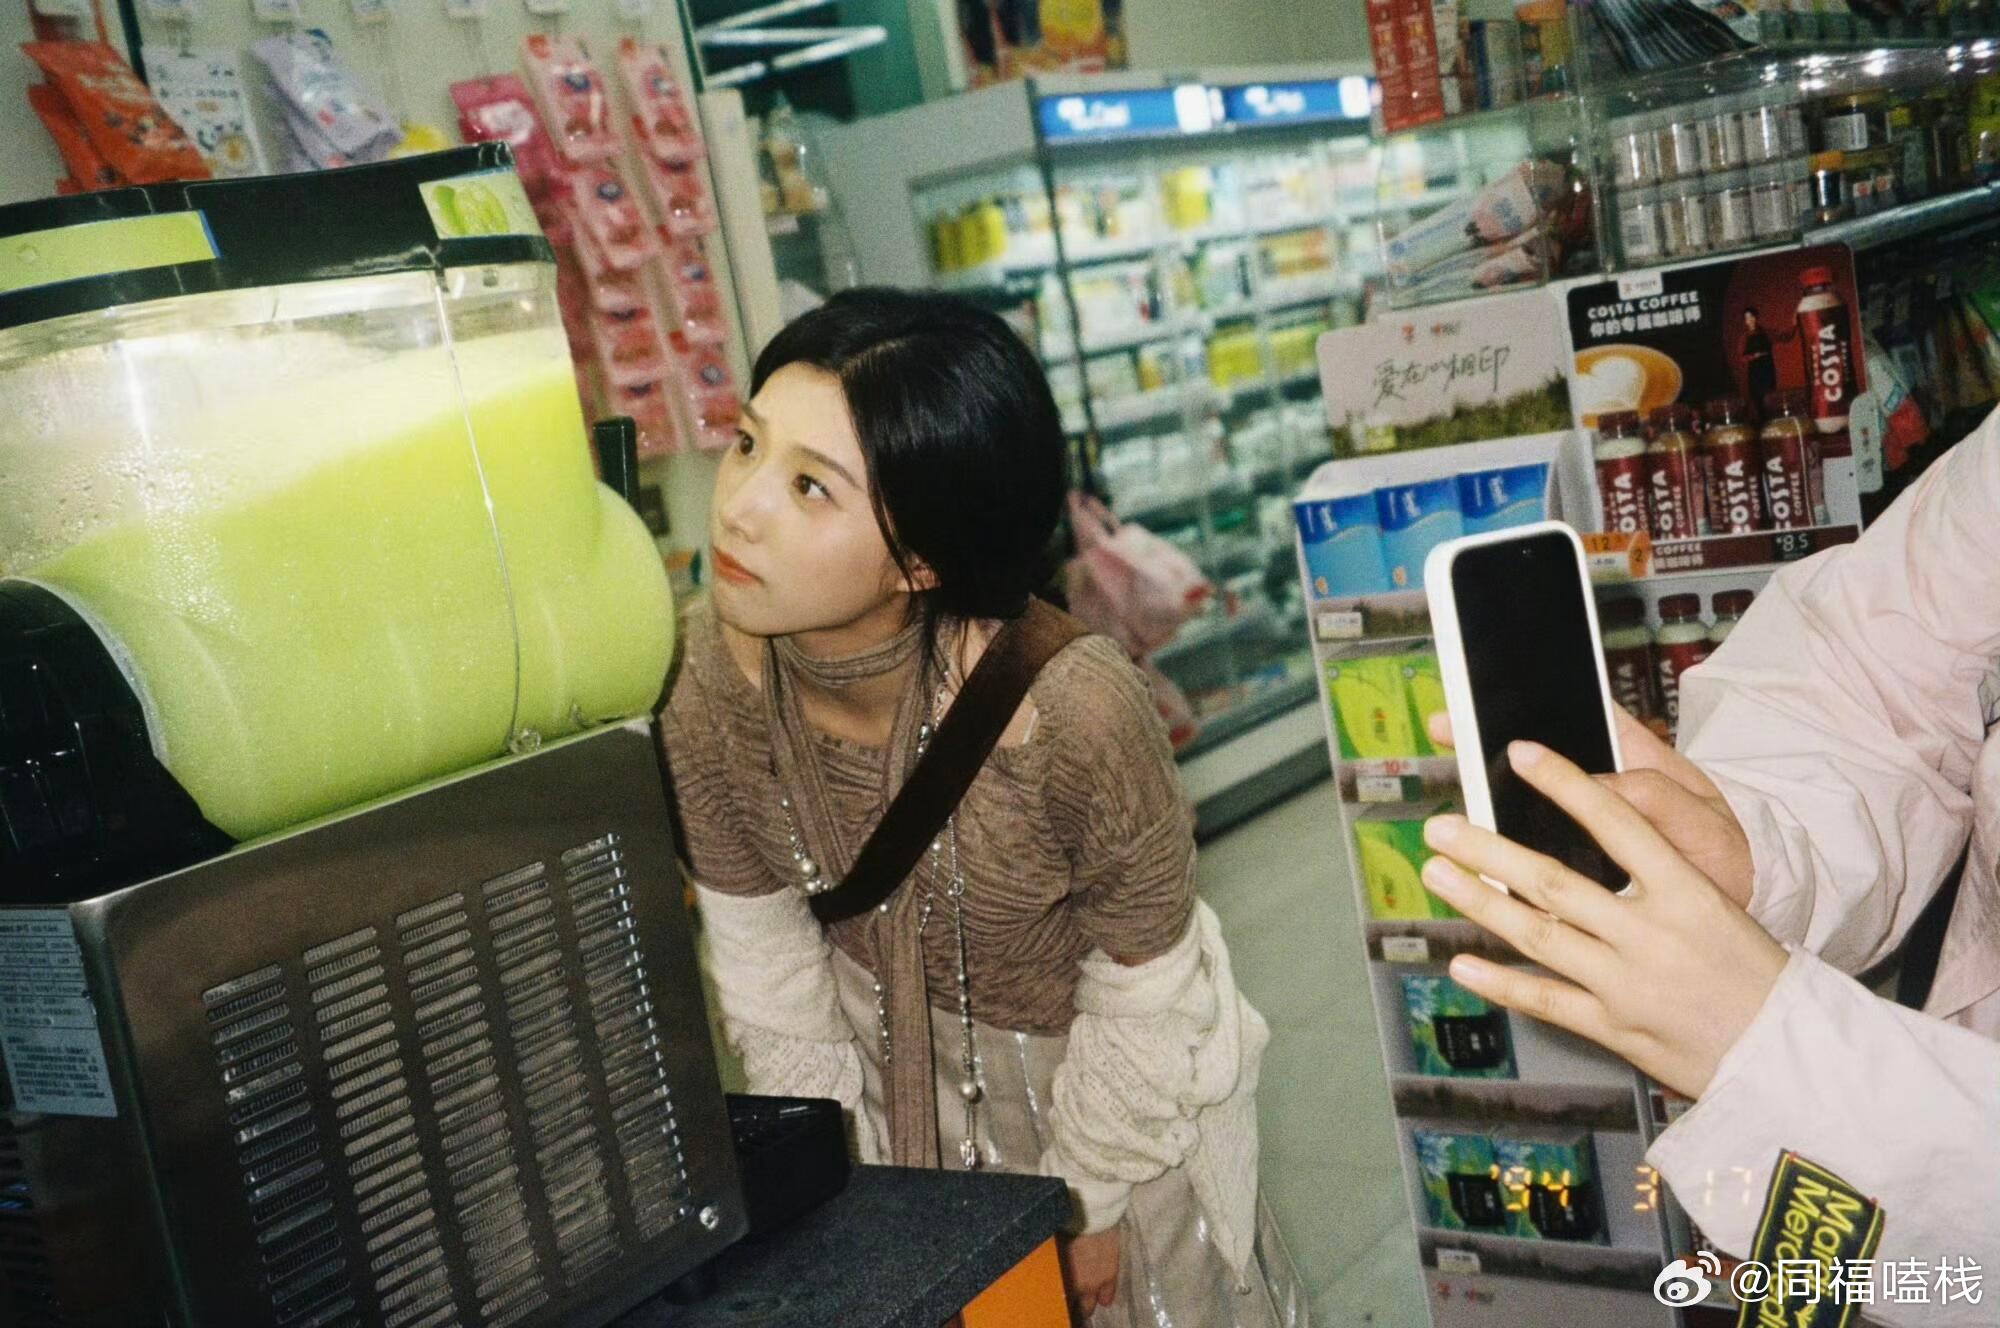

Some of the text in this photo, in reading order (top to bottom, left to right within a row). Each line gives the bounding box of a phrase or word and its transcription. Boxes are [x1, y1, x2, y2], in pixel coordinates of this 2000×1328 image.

[1587, 290, 1699, 320] COSTA COFFEE
[1818, 323, 1842, 402] COSTA
[1614, 472, 1636, 533] OSTA
[1655, 542, 1702, 556] COFFEE
[1755, 1175, 1830, 1328] Mercred
